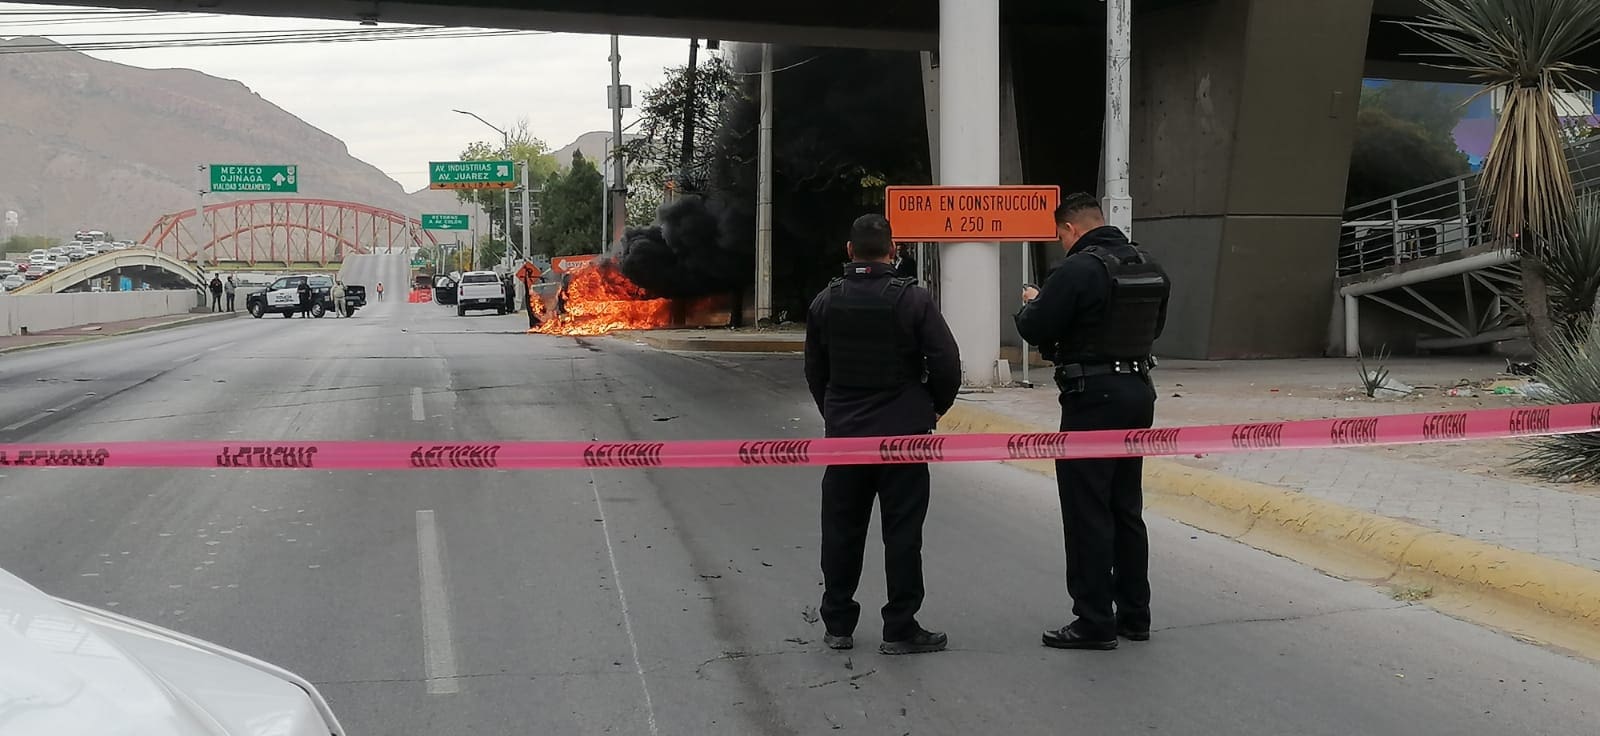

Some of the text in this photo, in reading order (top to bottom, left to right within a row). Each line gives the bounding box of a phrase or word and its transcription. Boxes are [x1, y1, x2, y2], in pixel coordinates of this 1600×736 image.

[221, 167, 263, 175] MEXICO
[448, 163, 492, 172] INDUSTRIAS
[438, 172, 489, 181] AV. JUAREZ
[213, 183, 271, 191] VIALIDAD SACRAMENTO
[899, 192, 1047, 212] OBRA EN CONSTRUCCIÓN
[944, 216, 1003, 232] A 250 m
